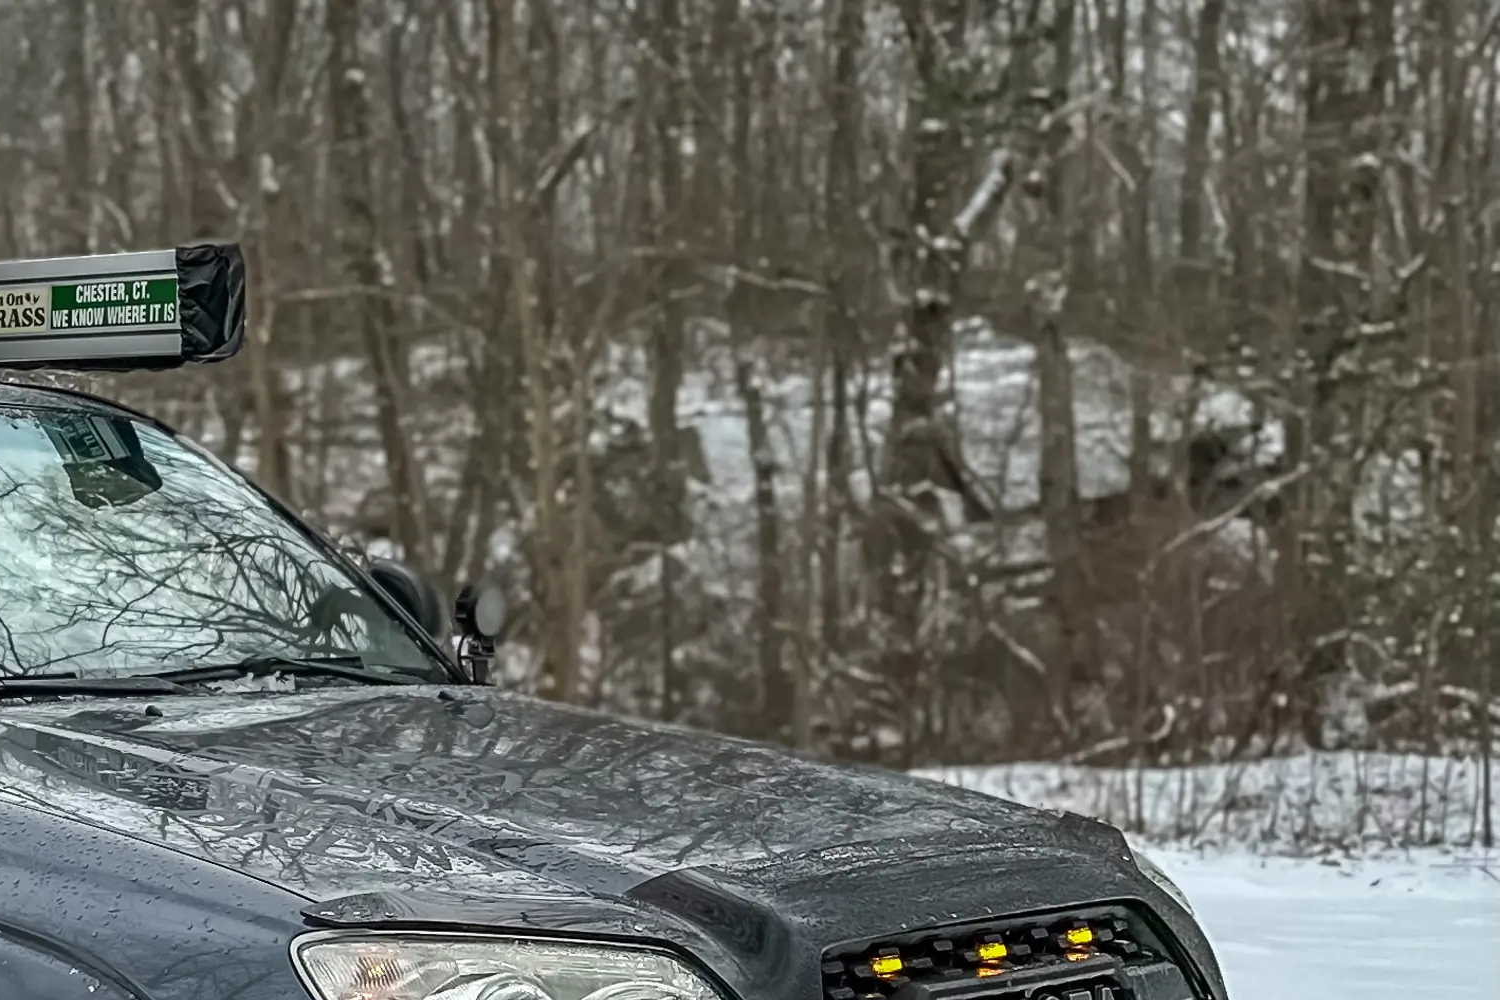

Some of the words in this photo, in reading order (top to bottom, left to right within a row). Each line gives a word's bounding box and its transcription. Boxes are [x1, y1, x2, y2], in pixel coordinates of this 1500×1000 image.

[6, 293, 24, 306] On
[75, 282, 129, 303] CHESTER,
[132, 281, 150, 300] CT.
[52, 310, 69, 327] WE
[71, 307, 105, 327] KNOW
[107, 304, 146, 324] WHERE
[149, 304, 161, 322] IT
[164, 303, 175, 321] IS
